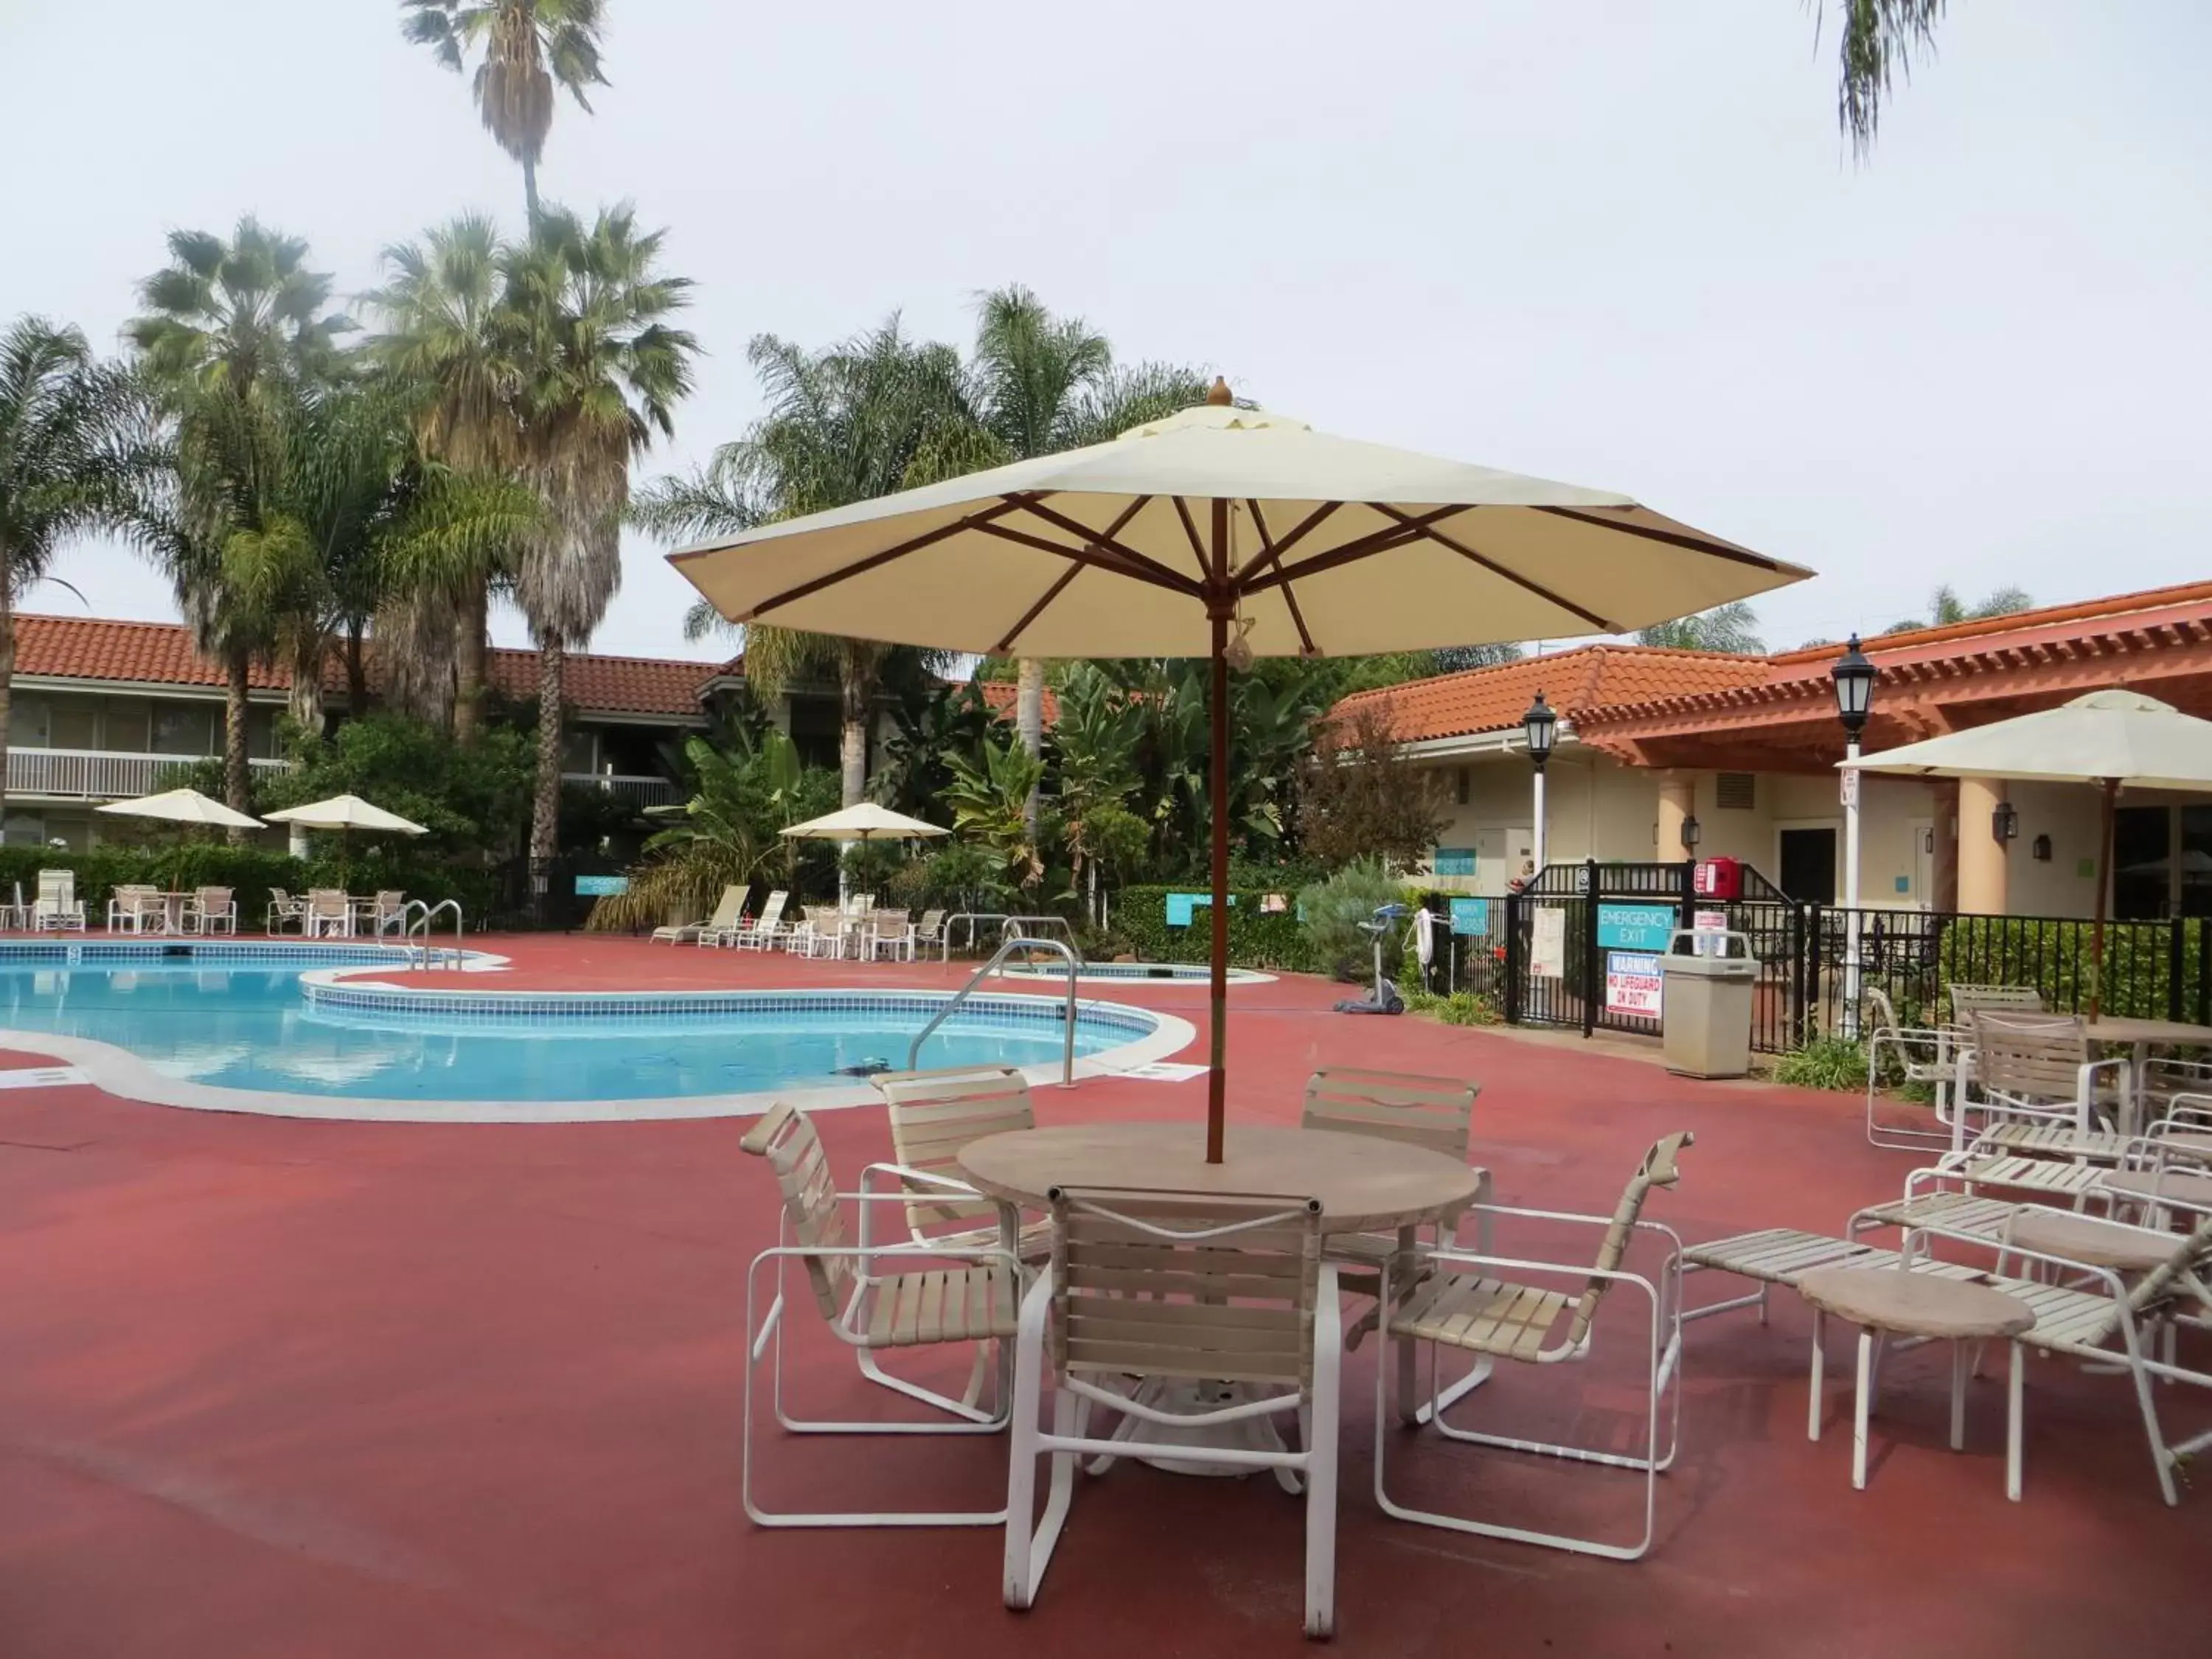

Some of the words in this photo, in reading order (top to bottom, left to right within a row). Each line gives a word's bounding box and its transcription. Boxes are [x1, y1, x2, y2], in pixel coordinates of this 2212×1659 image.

[1601, 908, 1673, 928] EMERGENCY
[1620, 929, 1646, 944] EXIT
[1612, 956, 1658, 975] WARNING
[1620, 975, 1660, 991] LIFEGUARD
[1617, 990, 1625, 1003] ON
[1628, 991, 1647, 1006] DUTY
